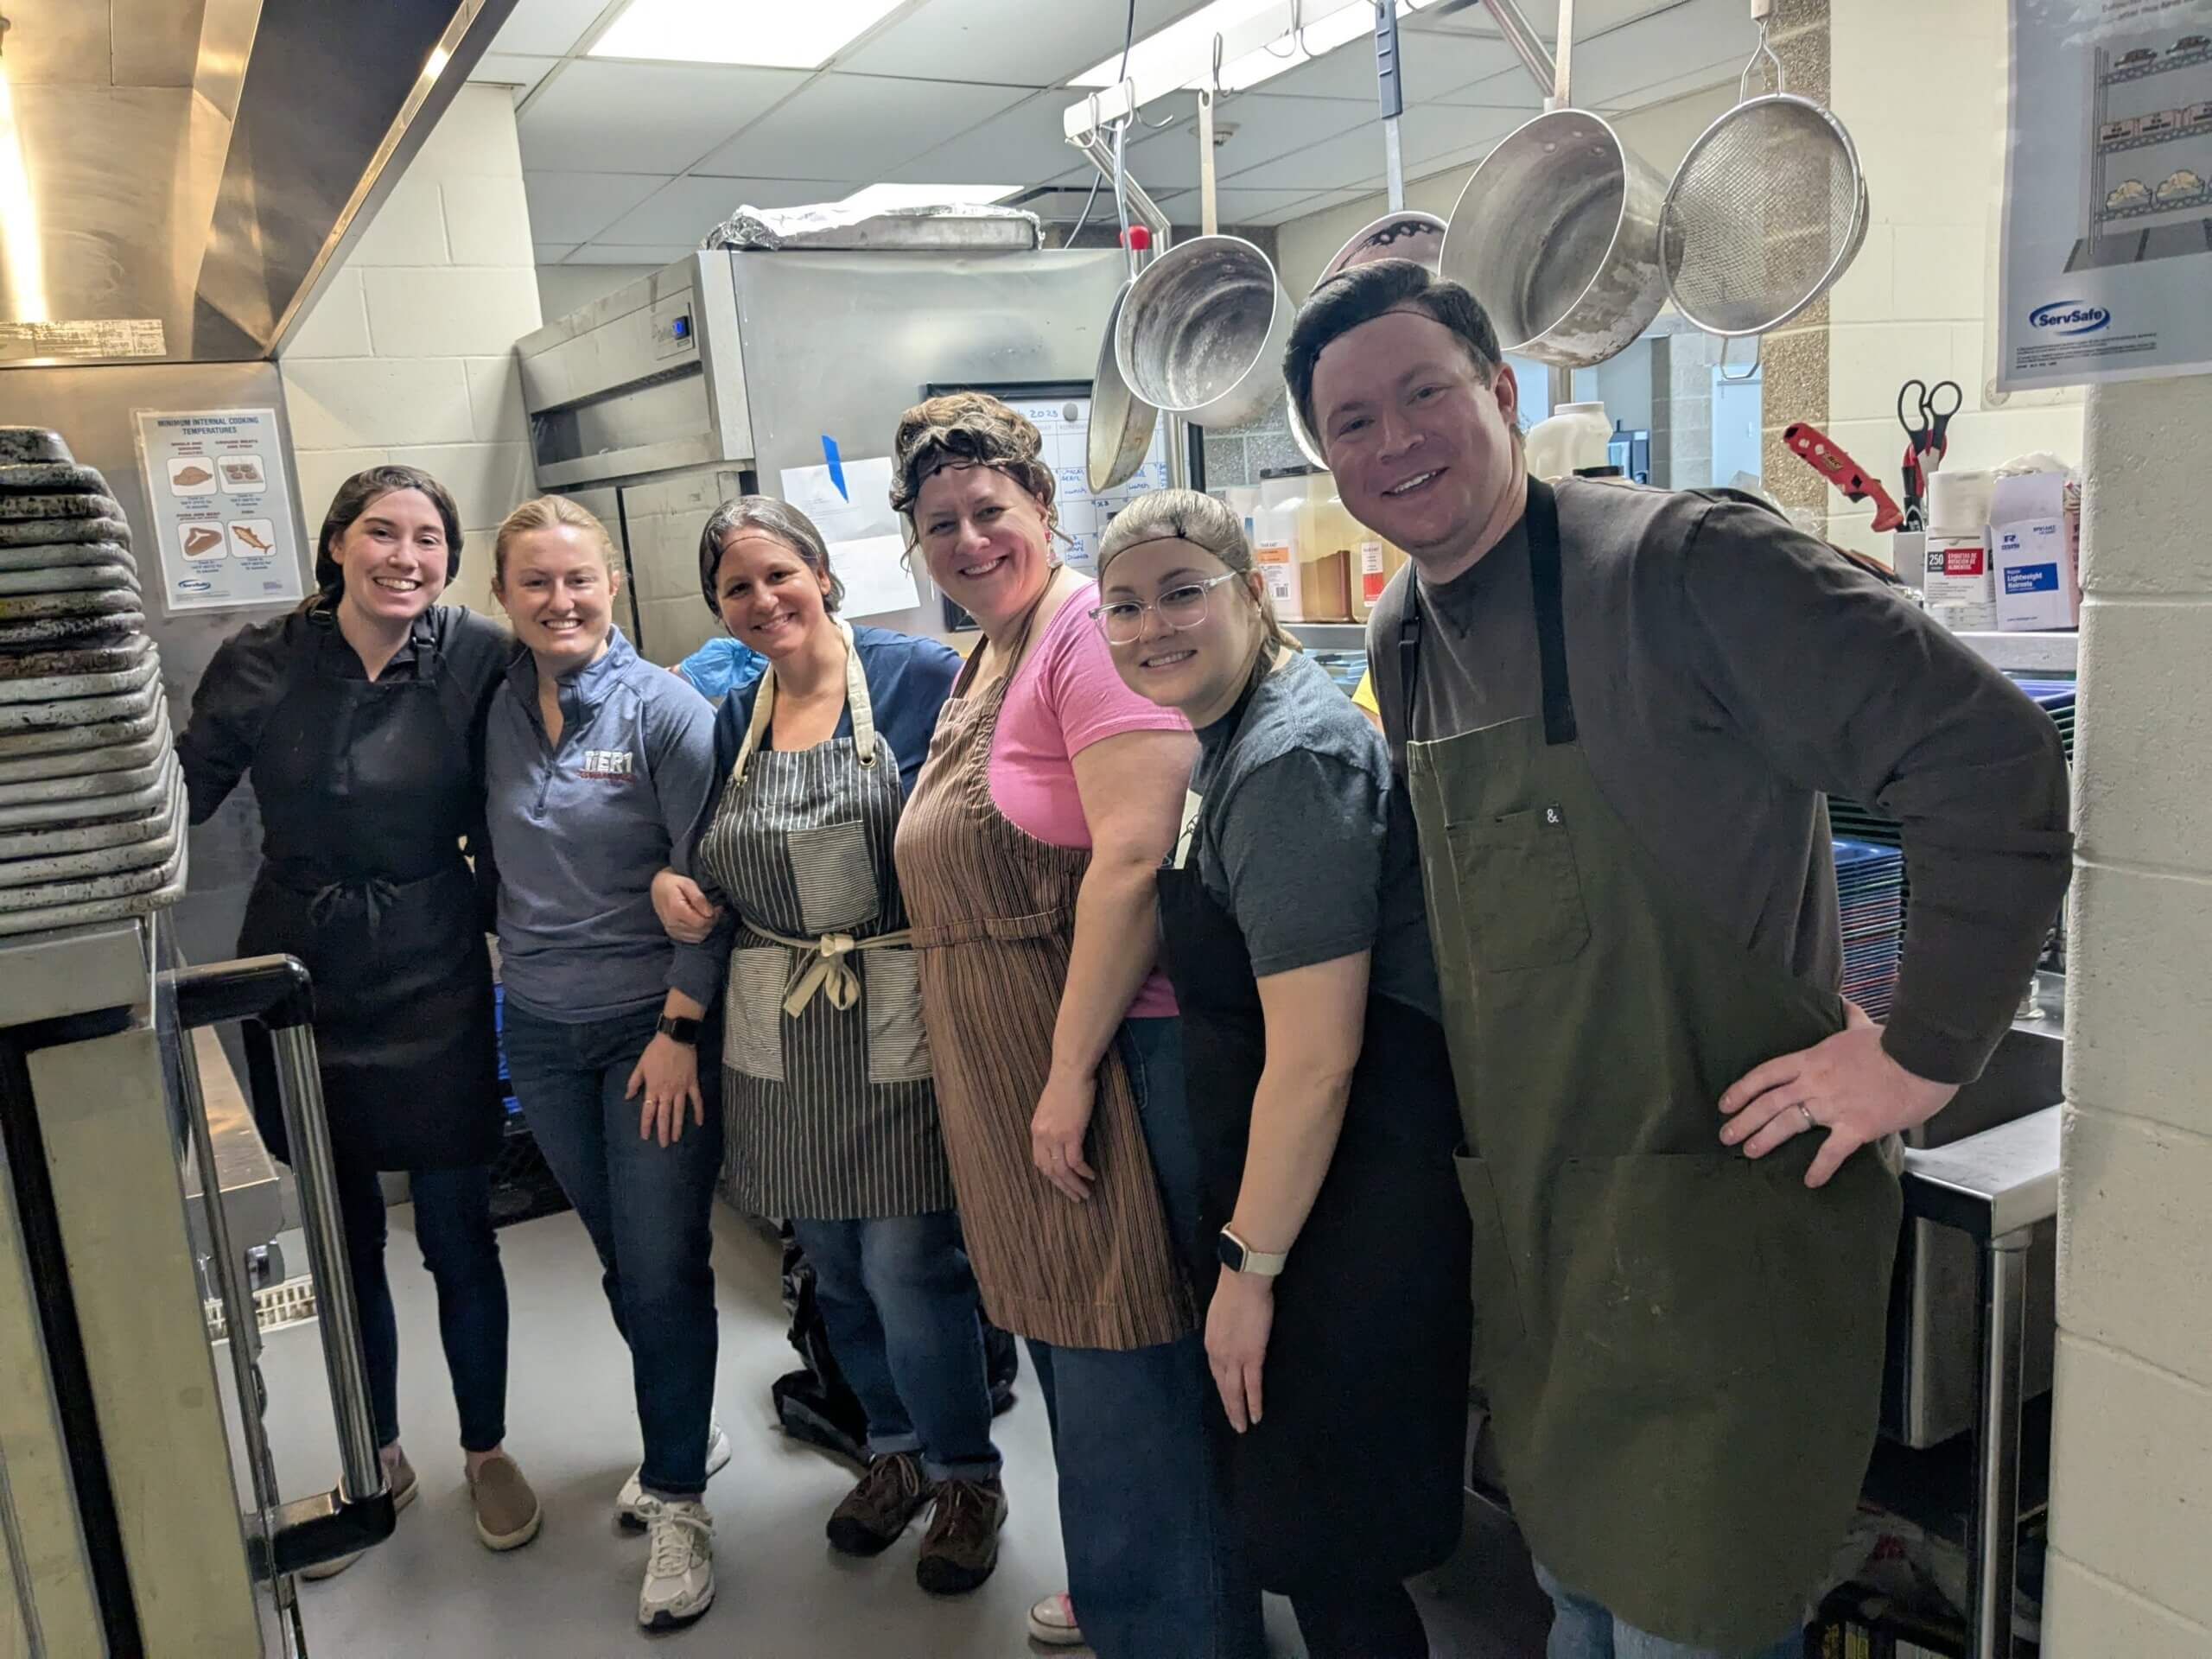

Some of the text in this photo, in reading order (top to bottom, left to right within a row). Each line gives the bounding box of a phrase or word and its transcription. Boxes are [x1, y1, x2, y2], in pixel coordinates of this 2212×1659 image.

[2039, 308, 2102, 327] ServSafe
[181, 426, 237, 435] TEMPERATURES
[1929, 554, 1944, 566] 250
[2007, 572, 2043, 582] Lightweight
